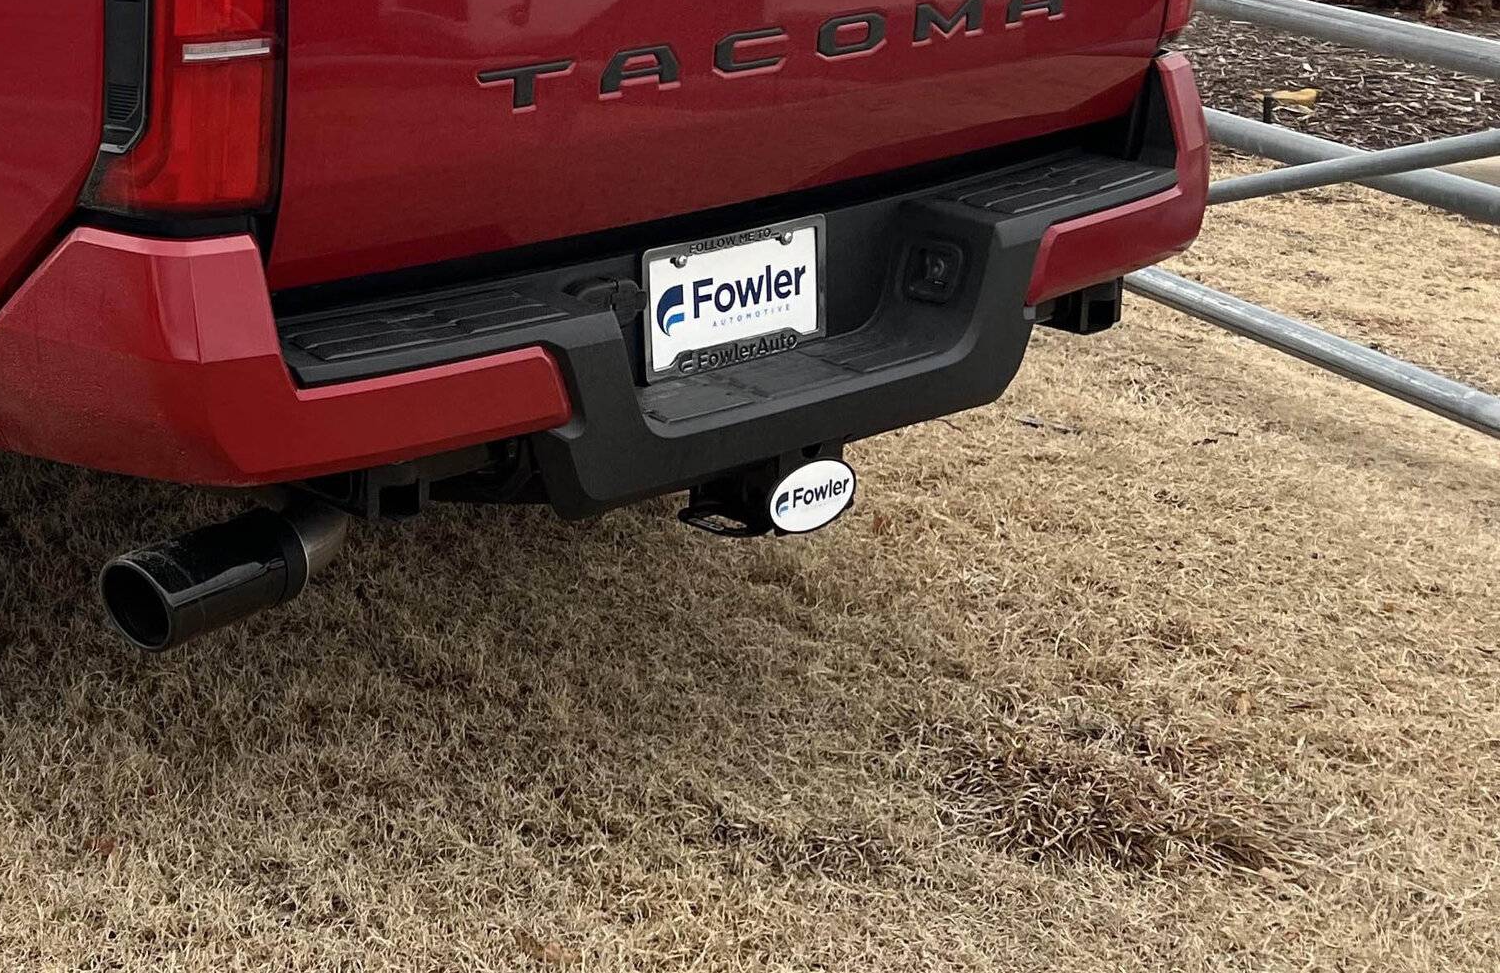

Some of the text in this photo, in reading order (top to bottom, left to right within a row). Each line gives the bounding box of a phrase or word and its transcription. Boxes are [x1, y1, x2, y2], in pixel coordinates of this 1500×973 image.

[688, 236, 736, 255] FOLLOW
[739, 231, 755, 244] ME
[693, 264, 806, 319] Fowler
[712, 303, 791, 328] AUTOMOTIVE
[698, 332, 798, 371] FowlerAuto
[792, 477, 850, 508] Fowler
